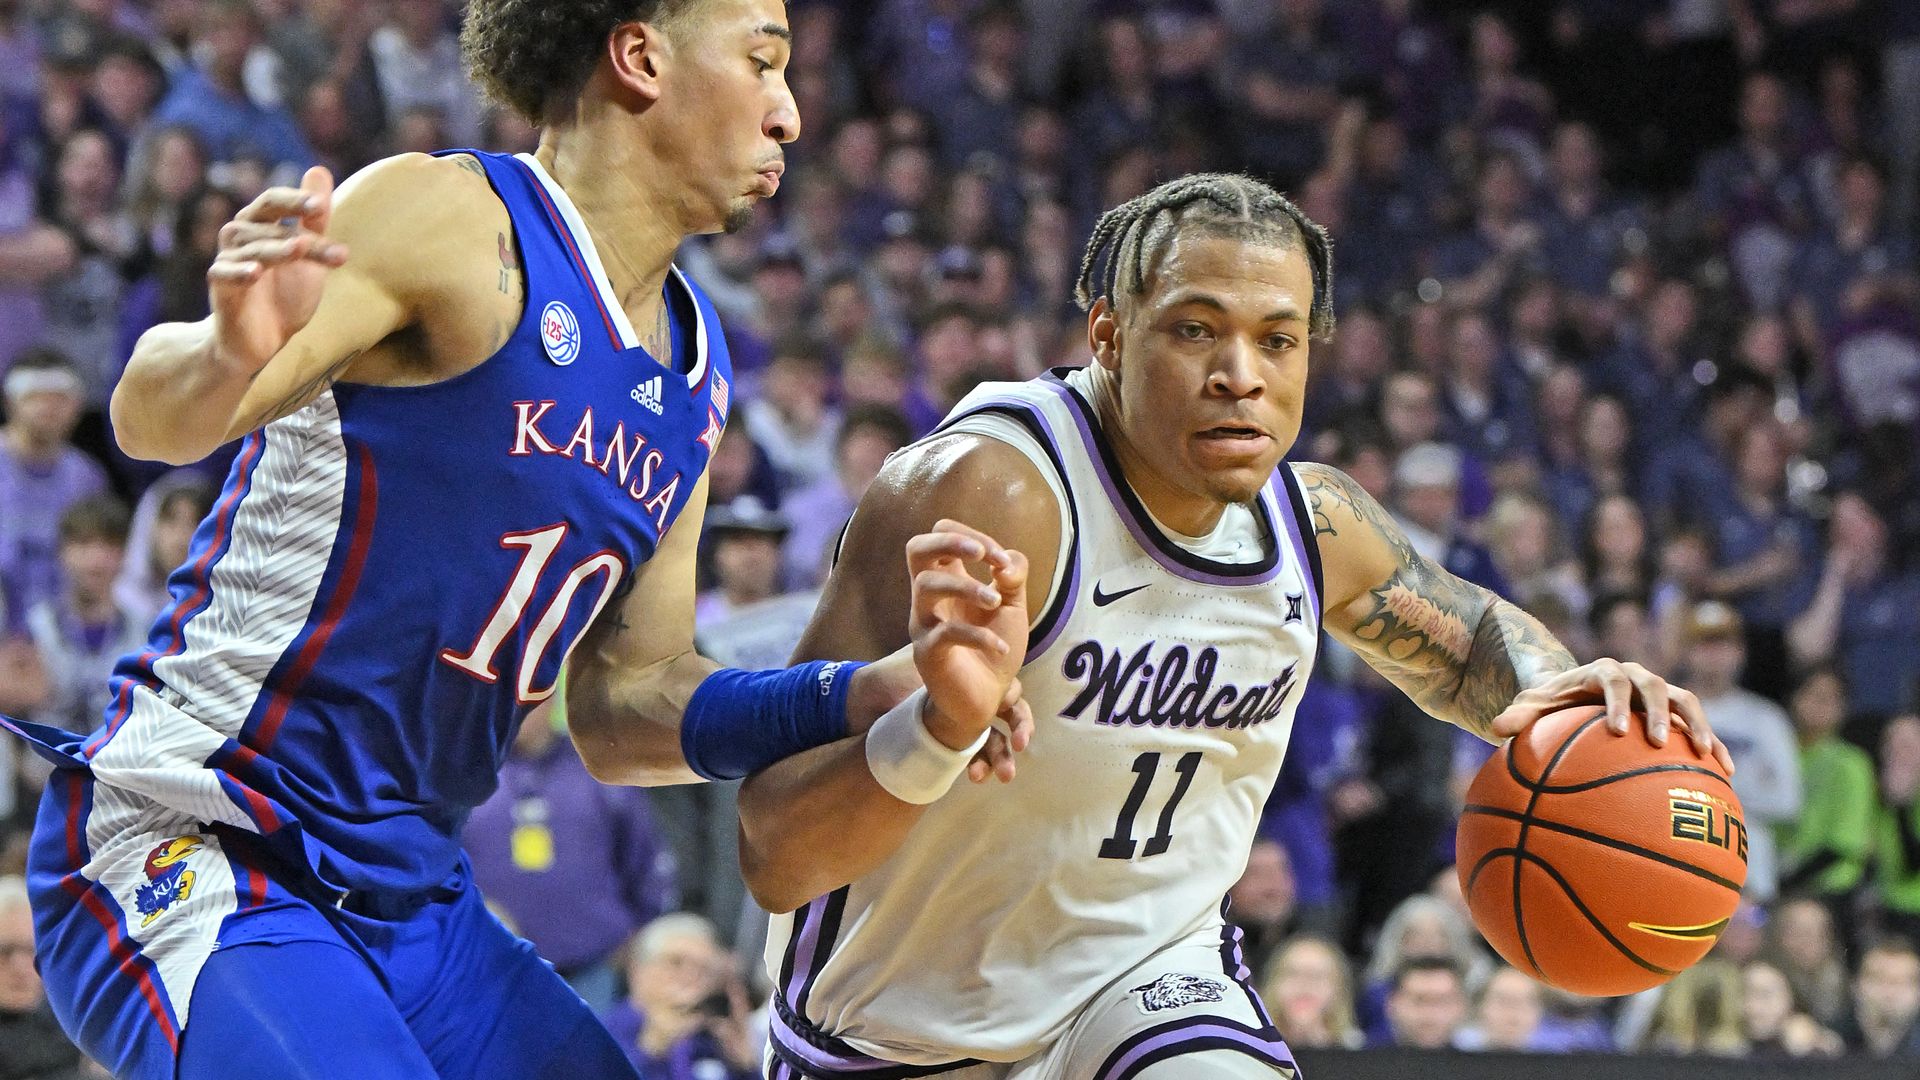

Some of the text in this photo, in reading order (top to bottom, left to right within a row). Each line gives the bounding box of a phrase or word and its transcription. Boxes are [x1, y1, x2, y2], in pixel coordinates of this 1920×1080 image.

[545, 316, 562, 342] 125
[630, 388, 664, 416] adidas
[508, 400, 682, 547] KANSA
[438, 521, 626, 705] 10
[1057, 639, 1299, 730] Wildcats
[1097, 751, 1203, 860] 11
[1670, 798, 1749, 867] ELITE
[153, 877, 172, 899] KU
